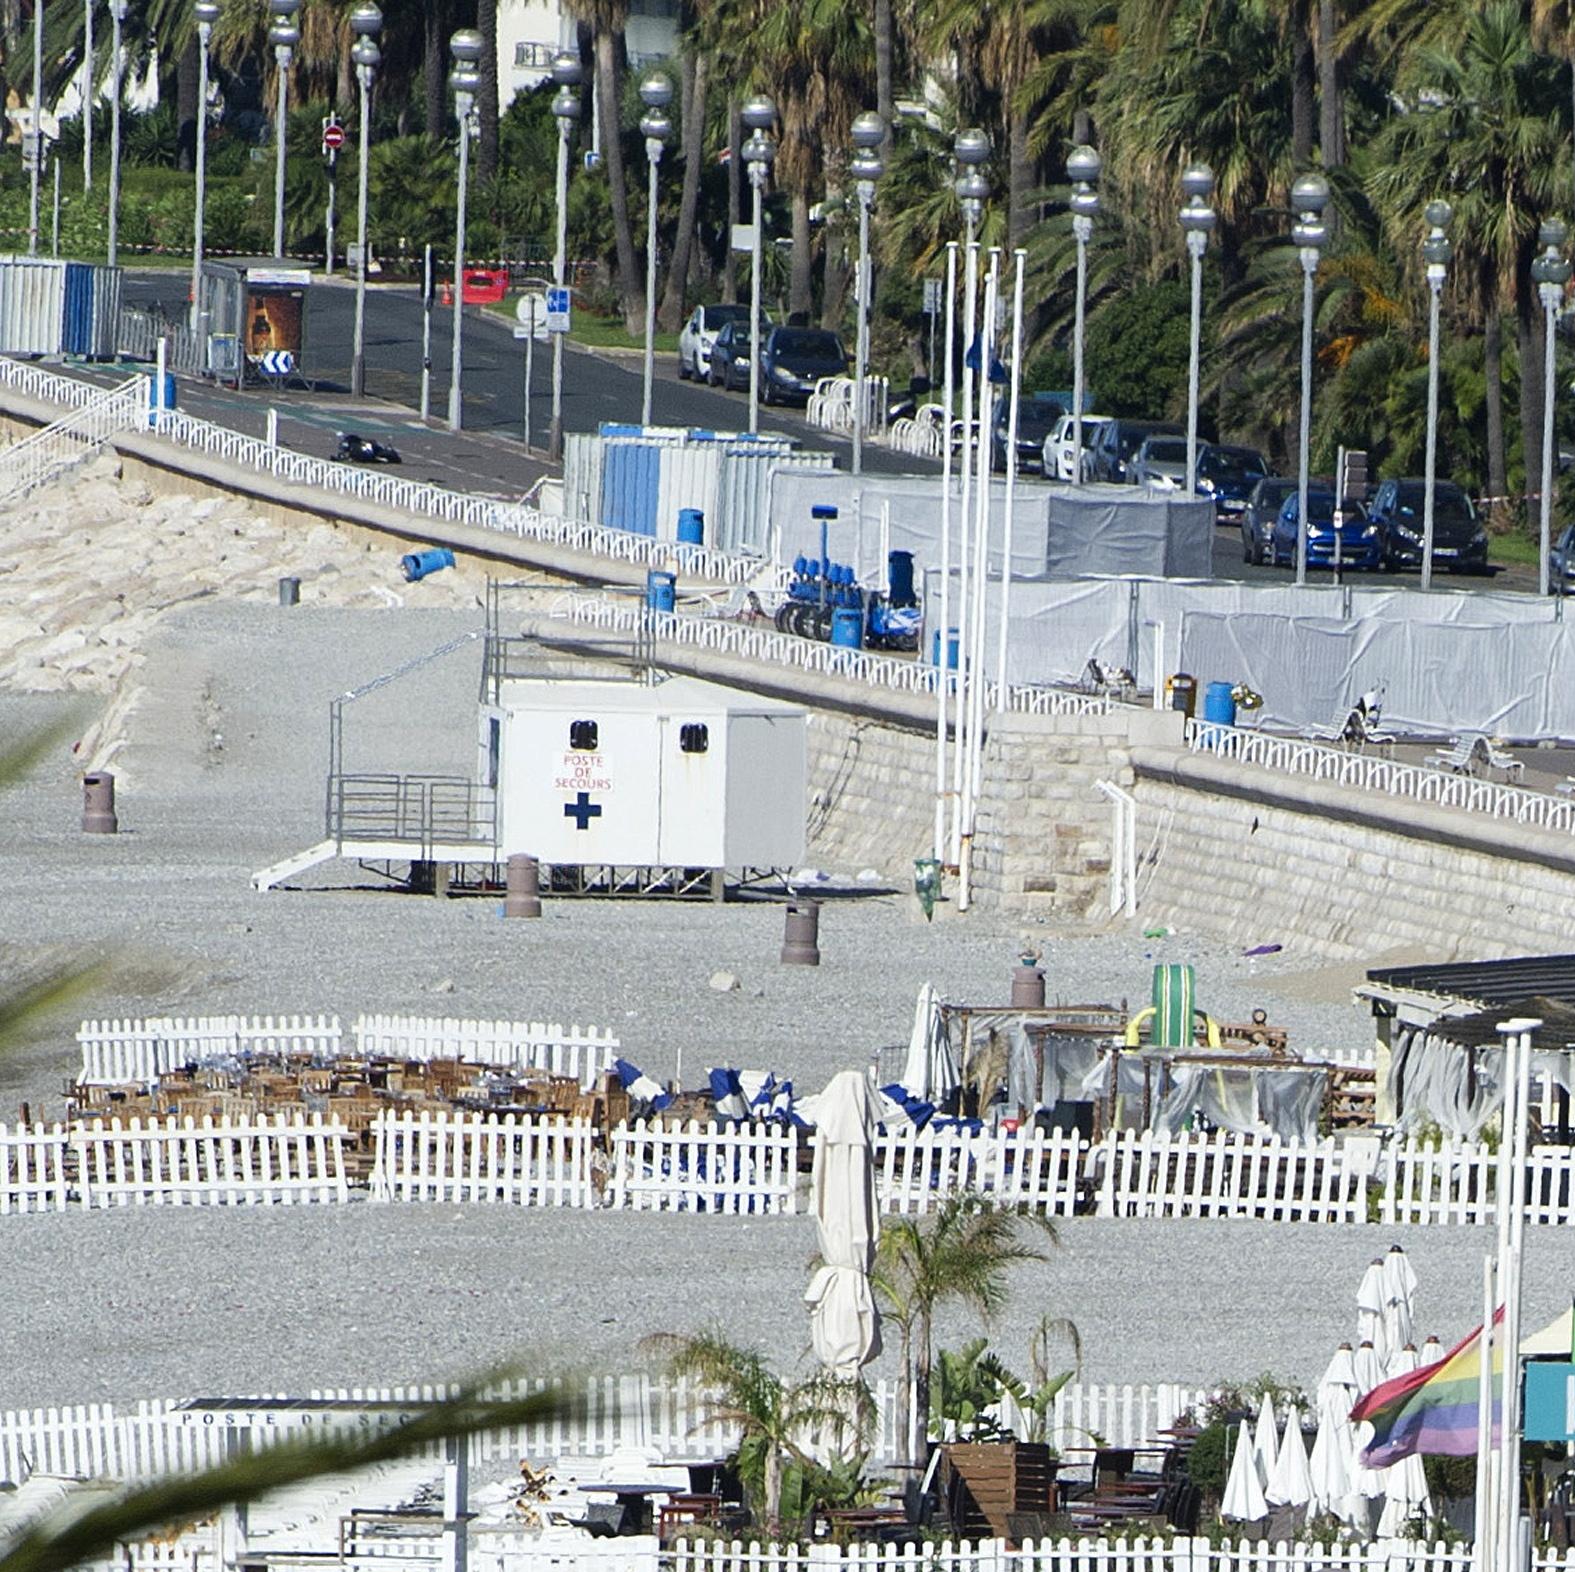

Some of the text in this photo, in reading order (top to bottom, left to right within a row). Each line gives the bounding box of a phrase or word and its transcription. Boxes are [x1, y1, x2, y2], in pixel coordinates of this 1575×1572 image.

[563, 754, 604, 767] POSTE
[574, 766, 592, 778] DE
[554, 778, 612, 790] SECOURS
[182, 1413, 277, 1426] POSTE
[301, 1413, 333, 1425] DE
